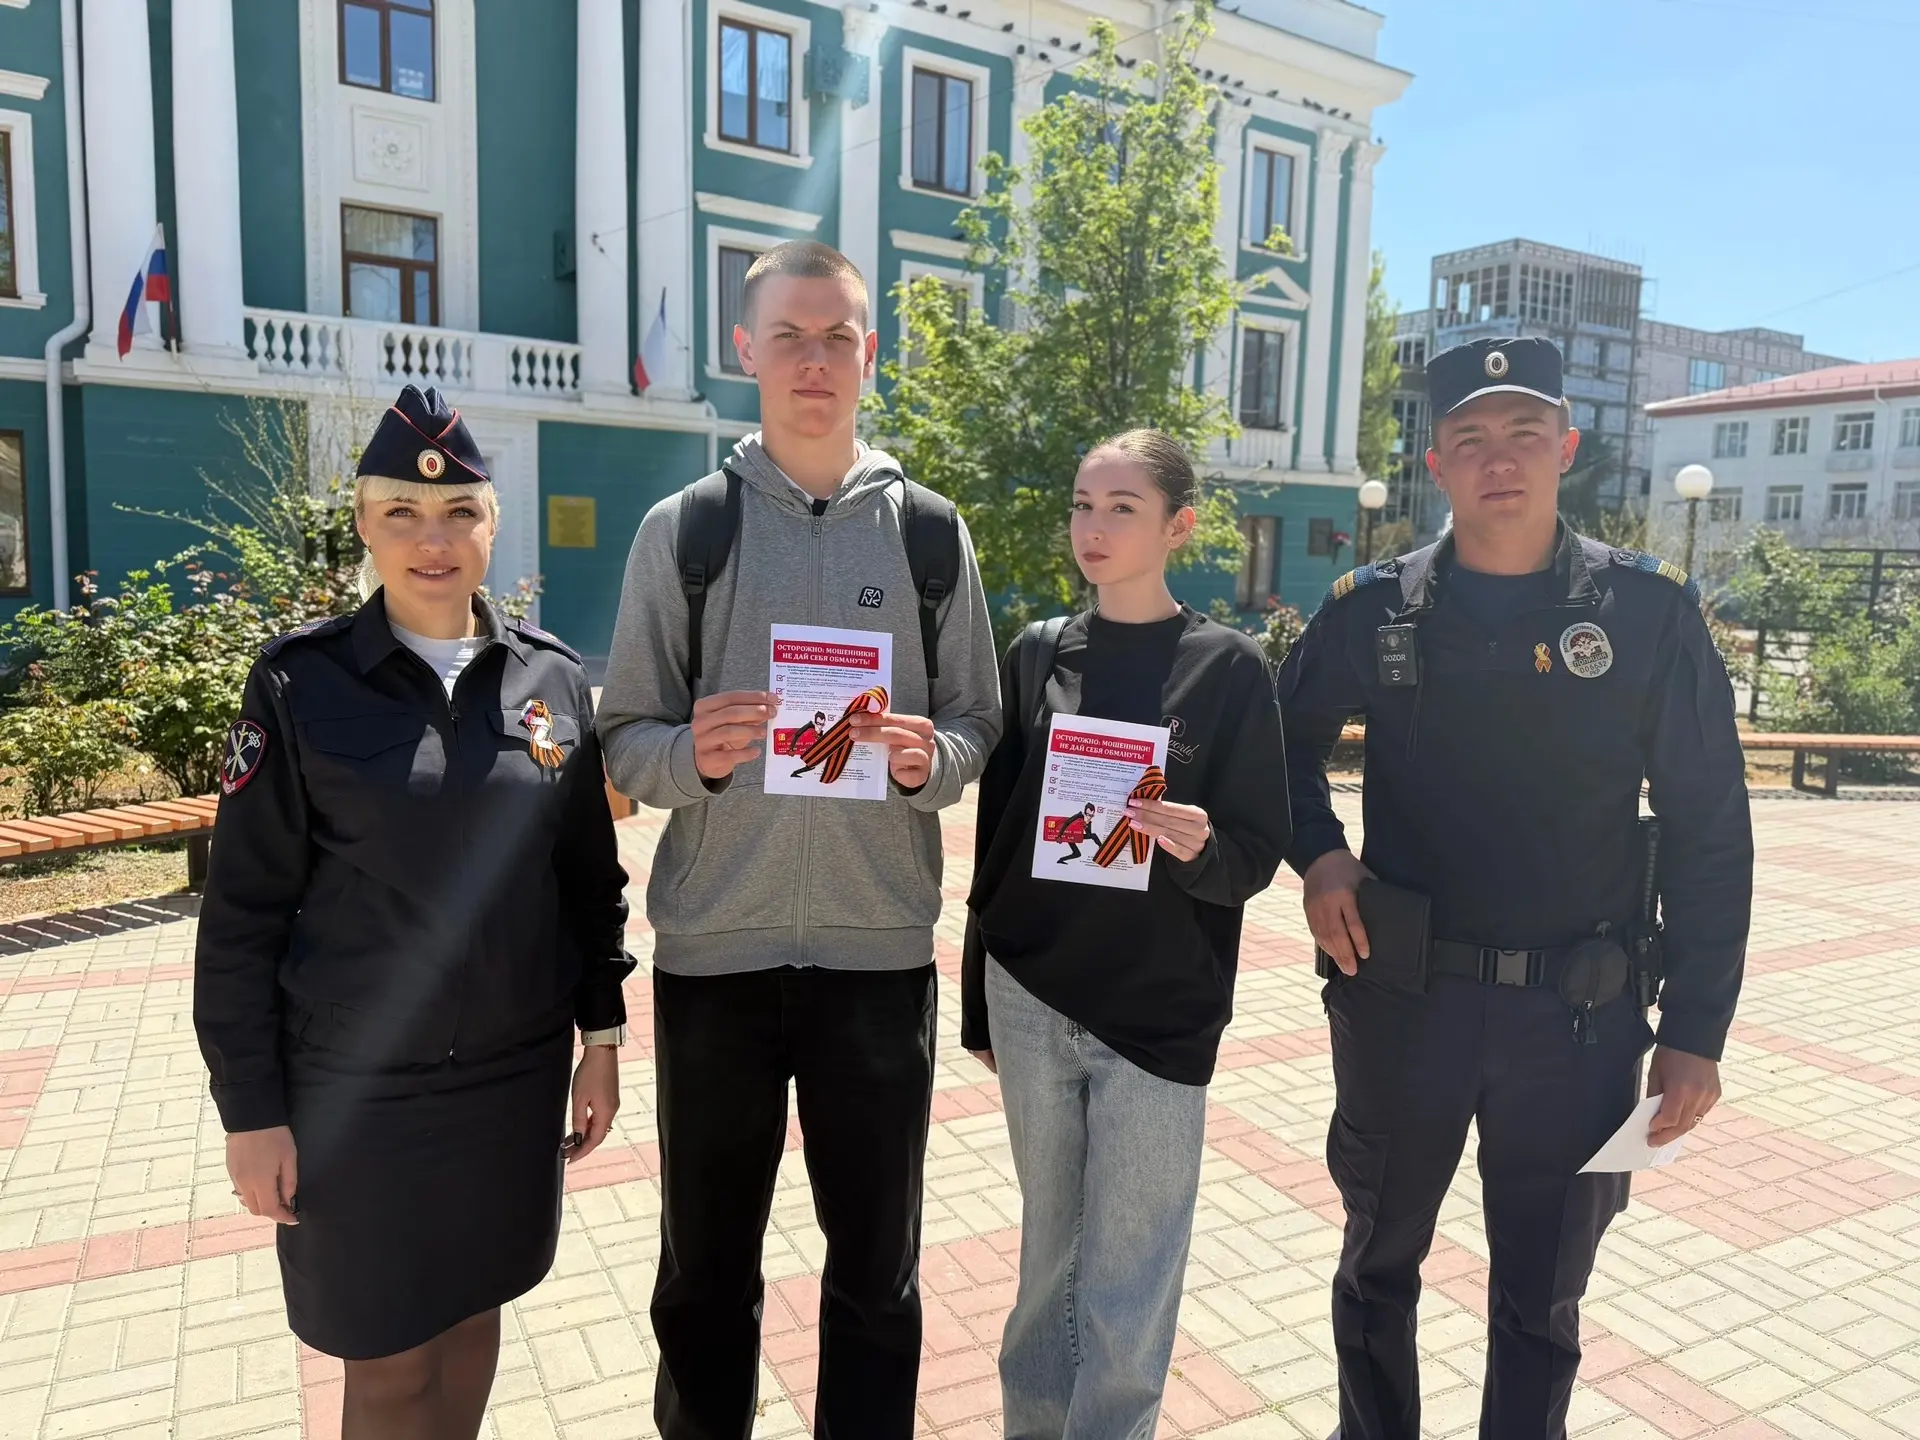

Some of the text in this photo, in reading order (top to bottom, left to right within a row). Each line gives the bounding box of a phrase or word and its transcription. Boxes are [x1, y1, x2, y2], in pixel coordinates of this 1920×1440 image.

[777, 644, 876, 658] ОСТОРОЖНО: МОШЕННИКИ!
[1383, 653, 1406, 662] DOZOR
[782, 652, 870, 665] НЕ ДАЙ СЕБЯ ОБМАНУТЬ!
[1055, 733, 1151, 752] ОСТОРОЖНО: МОШЕННИКИ!
[1069, 743, 1085, 752] ДАЙ
[1085, 746, 1103, 754] СЕБЯ
[1104, 748, 1145, 760] ОБМАНУТЬ!
